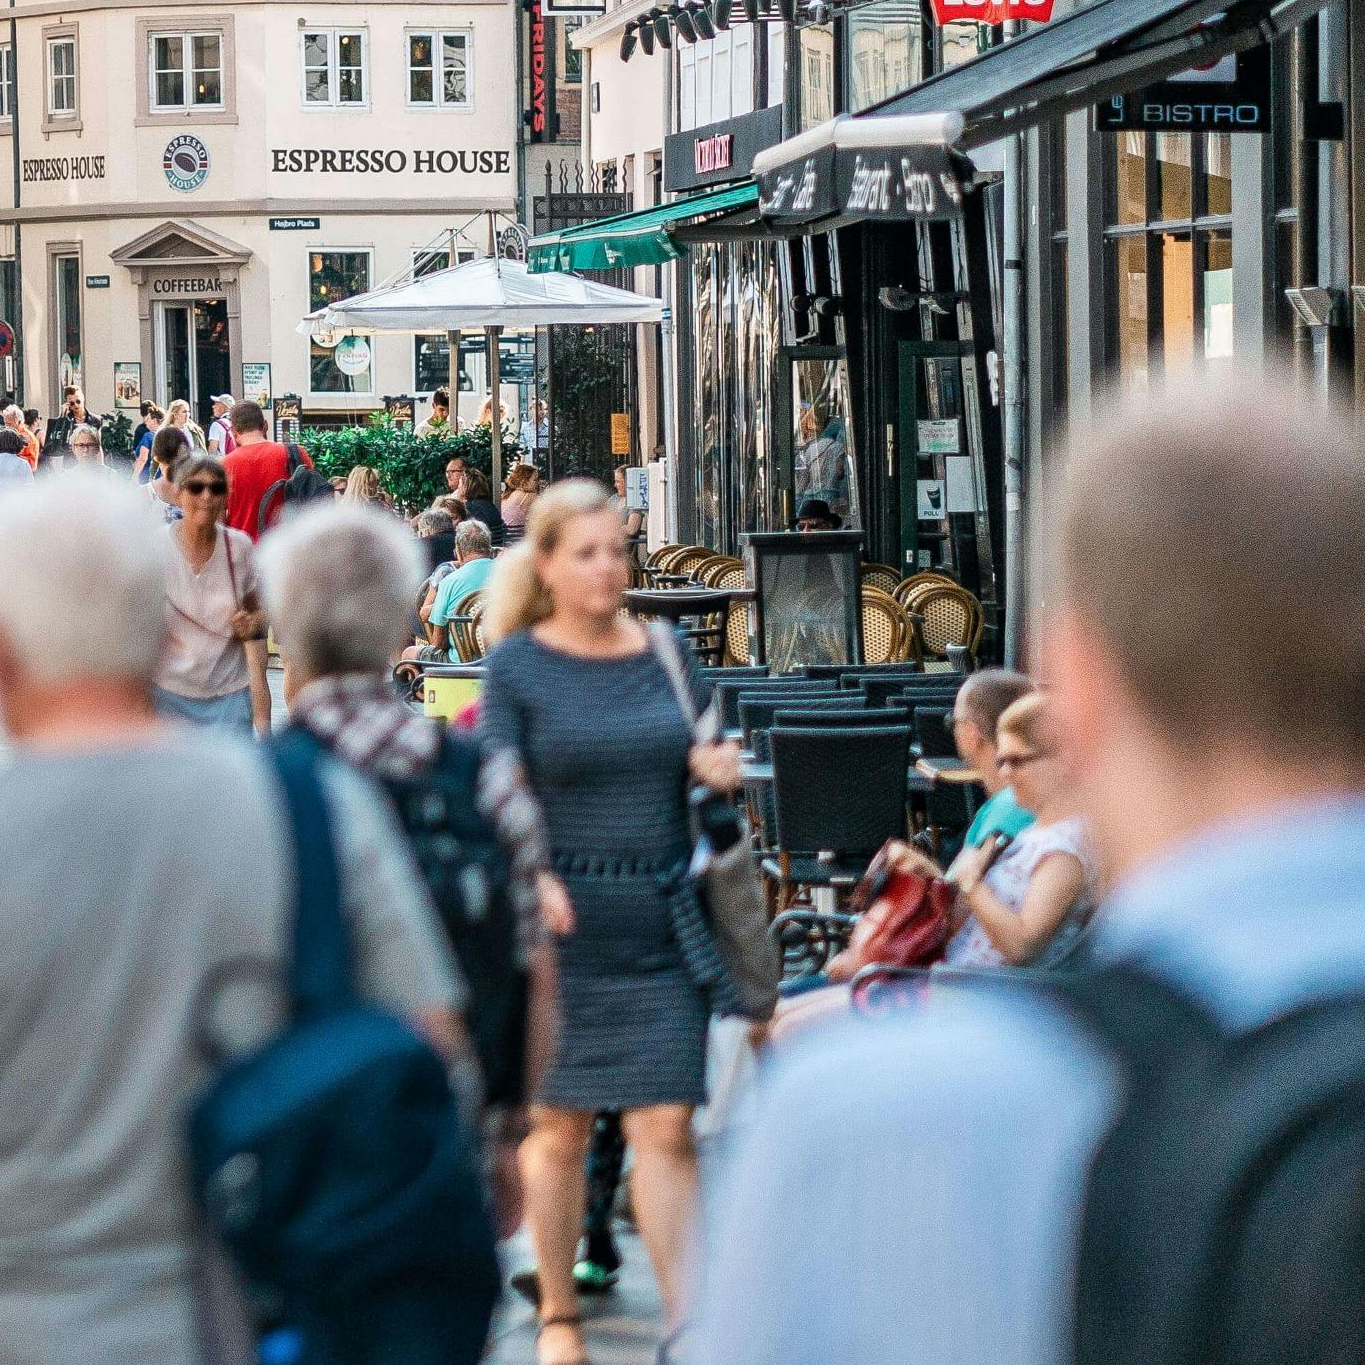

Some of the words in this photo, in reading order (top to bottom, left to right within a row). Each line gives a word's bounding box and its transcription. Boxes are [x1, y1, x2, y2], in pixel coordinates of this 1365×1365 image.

[1143, 104, 1260, 124] BISTRO
[166, 135, 207, 159] ESPRESSO
[23, 157, 69, 182] ESPRESSO
[71, 155, 105, 179] HOUSE
[271, 149, 407, 173] ESPRESSO
[413, 150, 511, 174] HOUSE
[170, 174, 202, 189] HOUSE
[153, 277, 223, 293] COFFEEBAR
